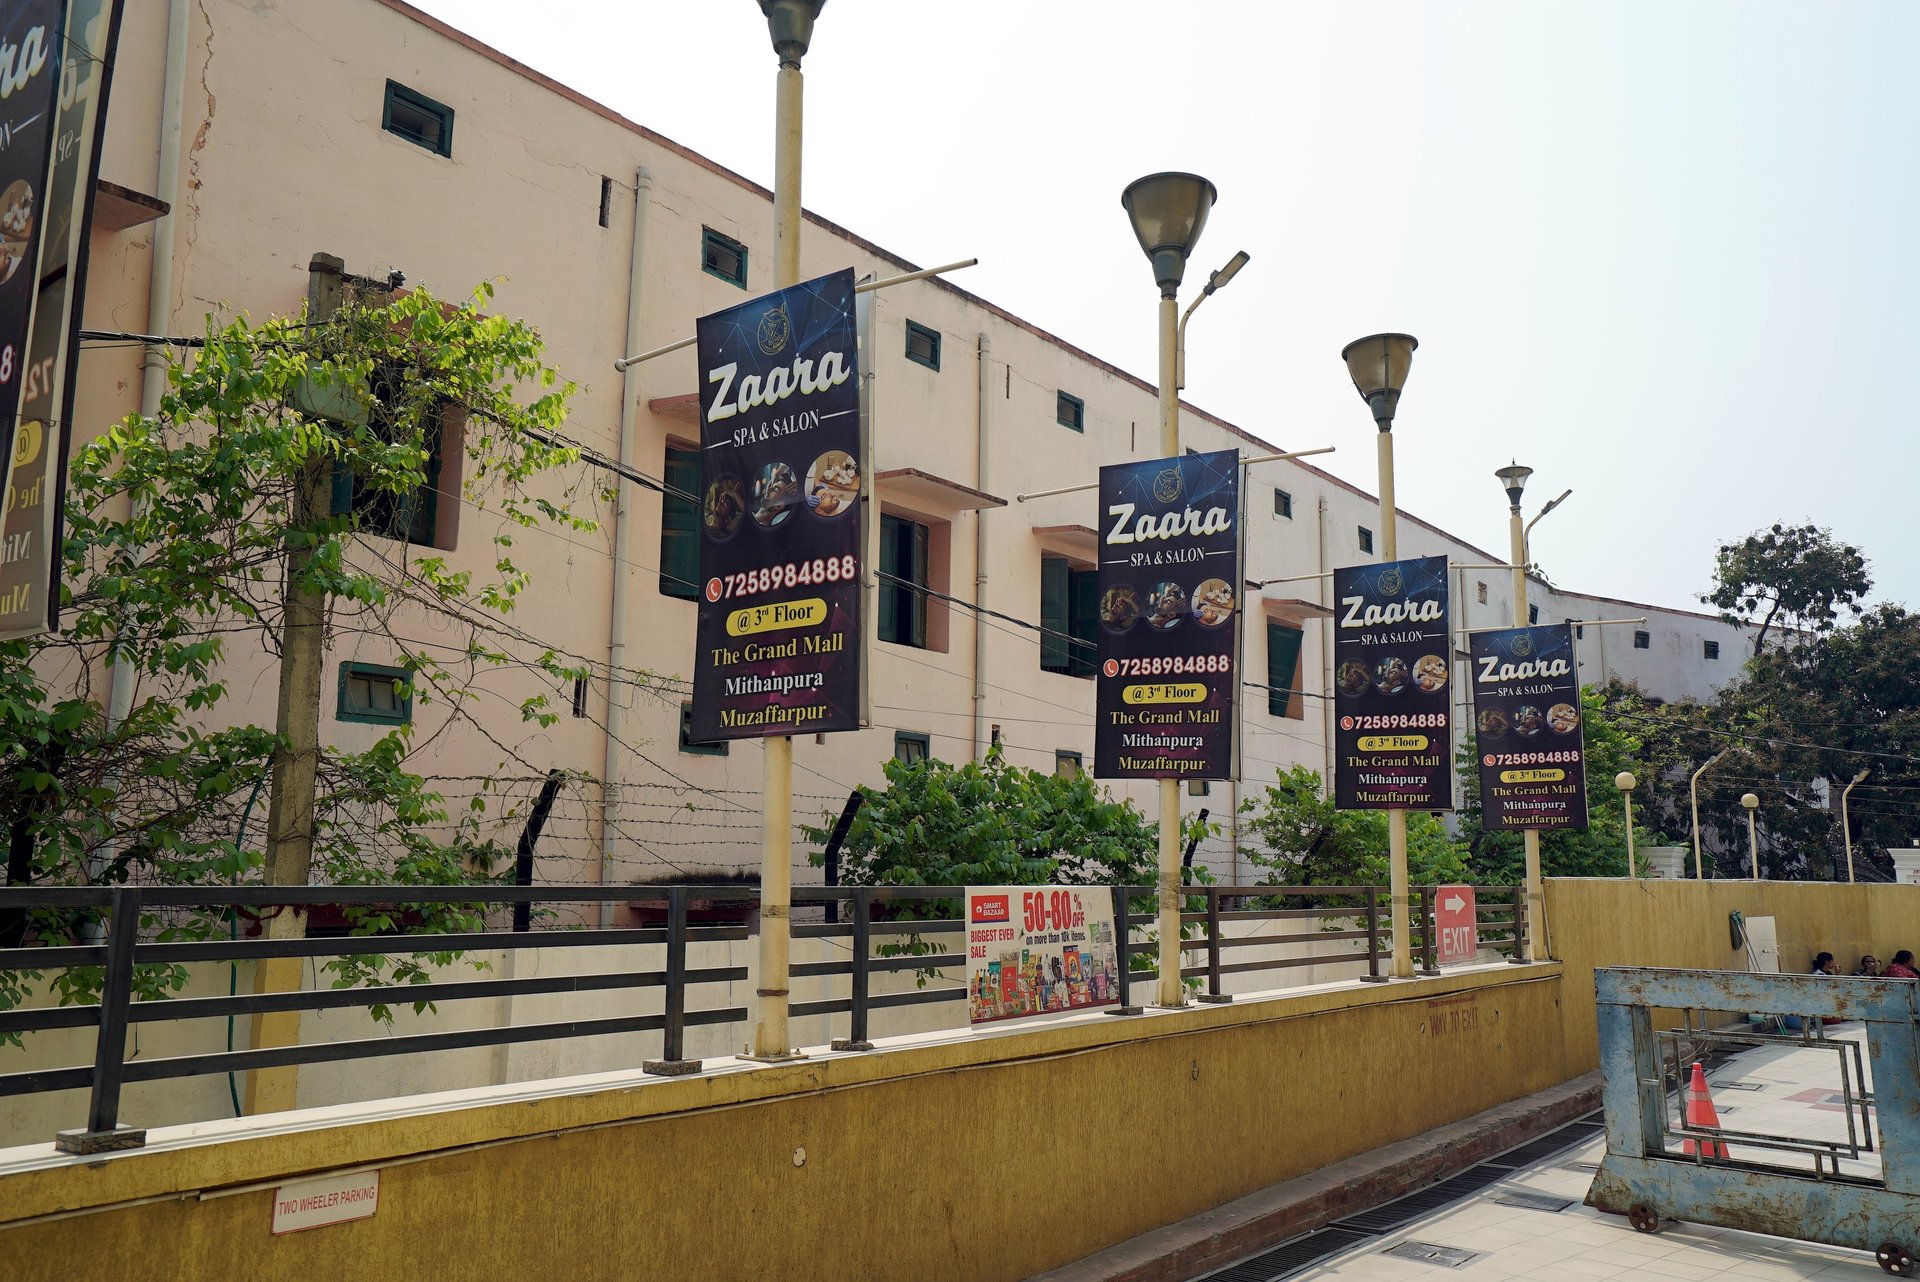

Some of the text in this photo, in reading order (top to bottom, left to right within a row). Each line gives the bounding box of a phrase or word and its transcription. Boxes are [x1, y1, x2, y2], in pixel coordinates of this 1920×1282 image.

[708, 351, 851, 423] Zaara
[733, 409, 820, 448] SPA & SALON
[1106, 502, 1232, 545] Zaara
[1130, 547, 1205, 567] SPA & SALON
[724, 554, 856, 600] 7258984888
[737, 604, 814, 633] @ 3rd Floor
[1340, 595, 1443, 628] Zaara
[1361, 630, 1423, 646] SPA & SALON
[711, 632, 843, 667] The Grand Mall
[1120, 654, 1230, 677] 7258984888
[1478, 656, 1571, 683] Zaara
[724, 671, 824, 697] Mithanpura
[1498, 684, 1554, 697] SPA & SALON
[1132, 685, 1197, 702] @ 3rd Floor
[719, 704, 827, 728] Muzaffarpur
[1110, 709, 1219, 724] The Grand Mall
[1354, 713, 1446, 730] 7258984888
[1122, 733, 1203, 750] Mithanpura
[1365, 738, 1376, 750] @
[1393, 737, 1420, 747] Floor
[1118, 756, 1206, 773] Muzaffarpur
[1347, 755, 1440, 767] The Grand Mall
[1496, 750, 1580, 766] 7258984888
[1358, 773, 1428, 787] Mithanpura
[1507, 772, 1517, 781] @
[1532, 771, 1557, 779] Floor
[1356, 791, 1431, 805] Muzaffarpur
[1491, 784, 1577, 796] The Grand Mall
[1503, 801, 1567, 811] Mithanpura
[1502, 815, 1570, 826] Muzaffarpur
[1074, 893, 1083, 911] %
[1023, 890, 1071, 932] 50-80
[1072, 911, 1085, 928] OFF
[970, 928, 1015, 943] BIGGEST EVER
[1026, 930, 1086, 946] on more than 10k items
[1442, 926, 1470, 956] EXIT
[970, 946, 987, 959] SALE
[1430, 1006, 1479, 1038] WAY TO EXIT
[278, 1186, 375, 1216] TWO WHEELER PARKING
